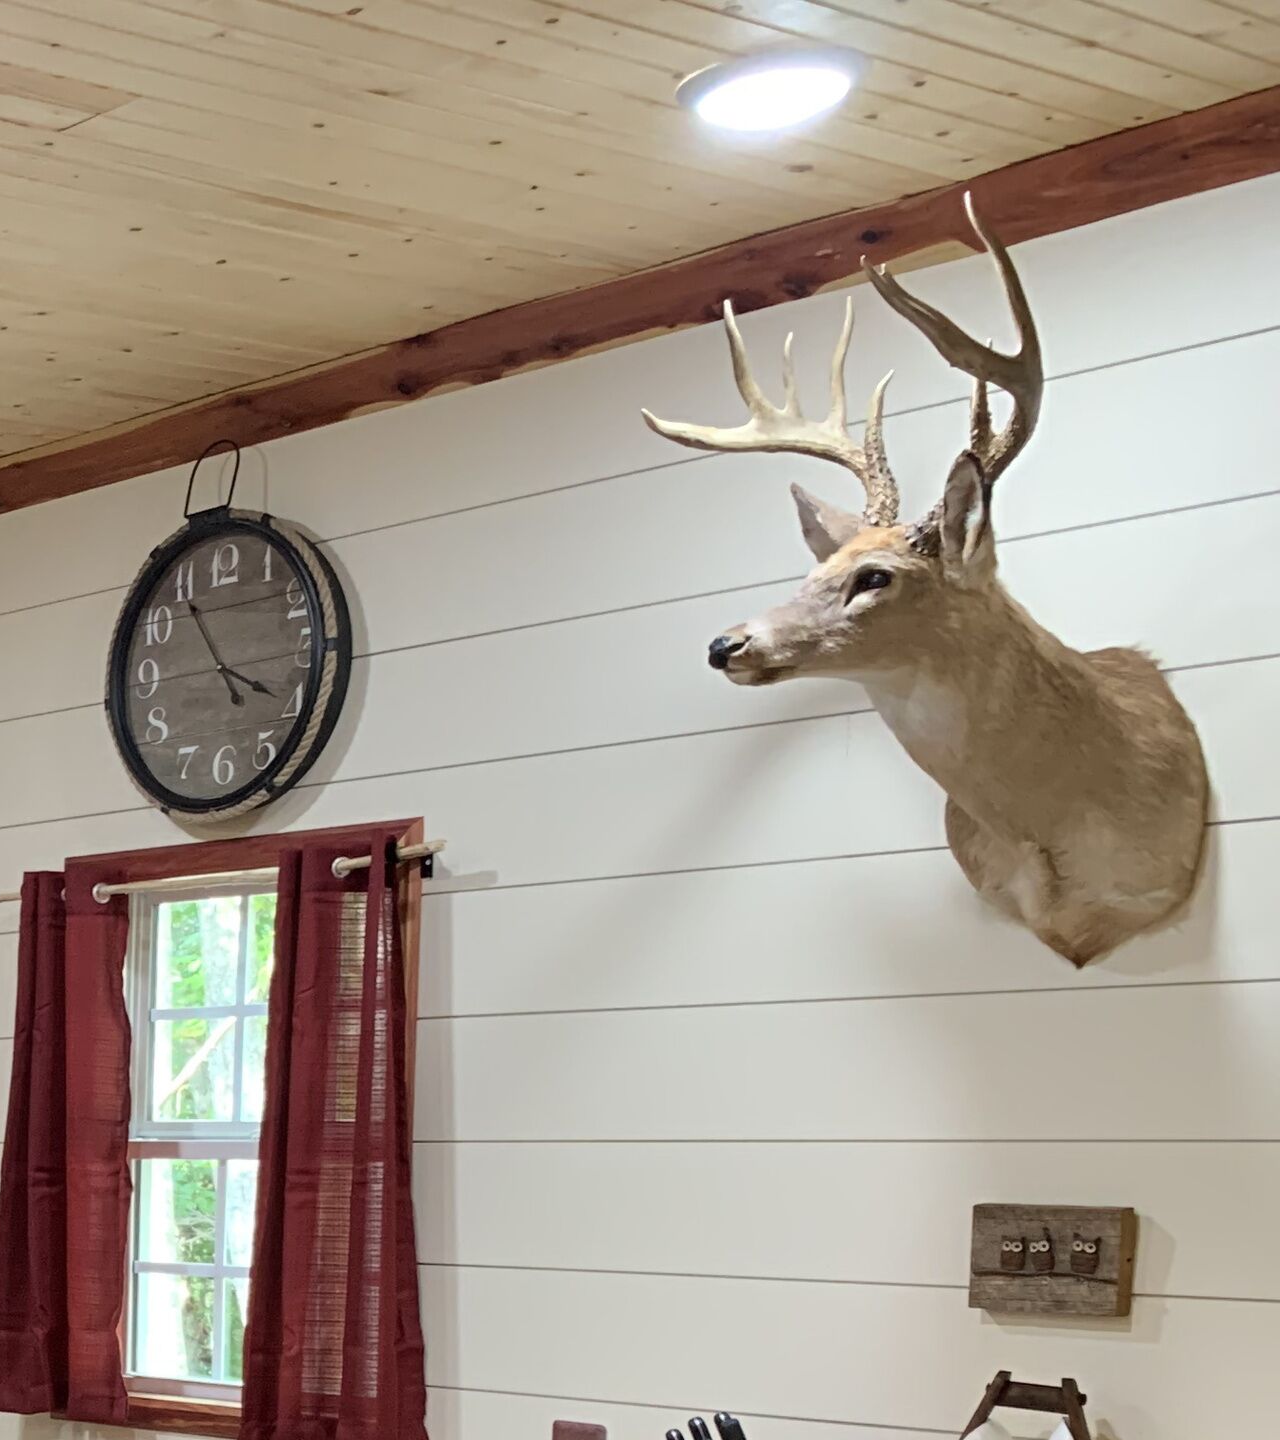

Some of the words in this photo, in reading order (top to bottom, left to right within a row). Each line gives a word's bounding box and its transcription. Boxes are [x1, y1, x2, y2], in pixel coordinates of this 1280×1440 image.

[174, 559, 194, 602] 11
[209, 543, 240, 588] 12
[262, 544, 274, 583] 1
[286, 576, 308, 620] 2
[144, 605, 173, 647] 10
[136, 658, 160, 699] 9
[281, 681, 303, 718] 4
[145, 706, 169, 745] 8
[177, 744, 200, 780] 7
[212, 744, 237, 785] 6
[252, 730, 277, 770] 5
